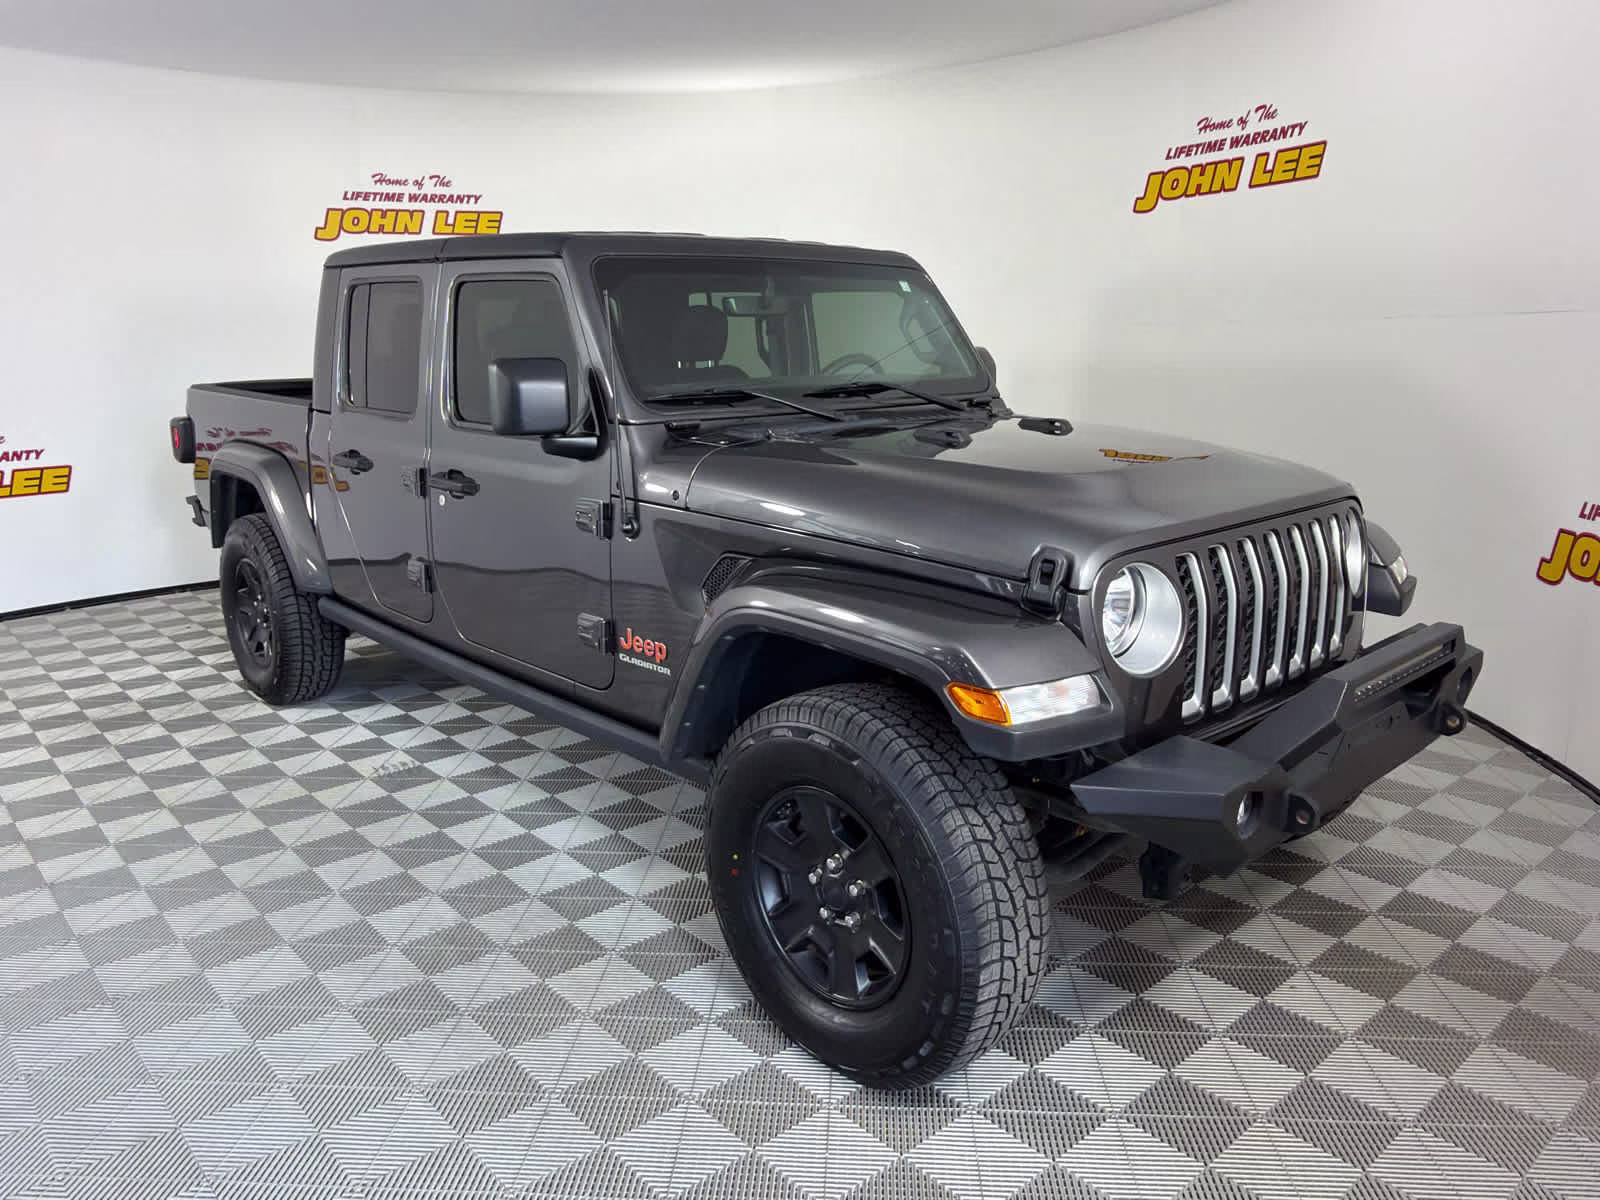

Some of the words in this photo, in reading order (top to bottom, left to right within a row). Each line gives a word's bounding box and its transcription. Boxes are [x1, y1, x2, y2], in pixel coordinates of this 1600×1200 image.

[1197, 117, 1233, 134] Home
[1237, 109, 1251, 129] of
[1254, 104, 1278, 123] The
[1165, 138, 1226, 160] LIFETIME
[1229, 121, 1308, 150] WARRANTY
[371, 173, 409, 187] Home
[412, 176, 424, 190] of
[428, 174, 452, 188] The
[1133, 156, 1245, 214] JOHN
[1248, 140, 1328, 189] LEE
[342, 190, 405, 203] LIFETIME
[408, 192, 482, 205] WARRANTY
[314, 207, 424, 241] JOHN
[432, 210, 503, 236] LEE
[1536, 528, 1600, 586] JO
[619, 627, 667, 665] Jeep
[618, 653, 672, 677] GLADIATOR
